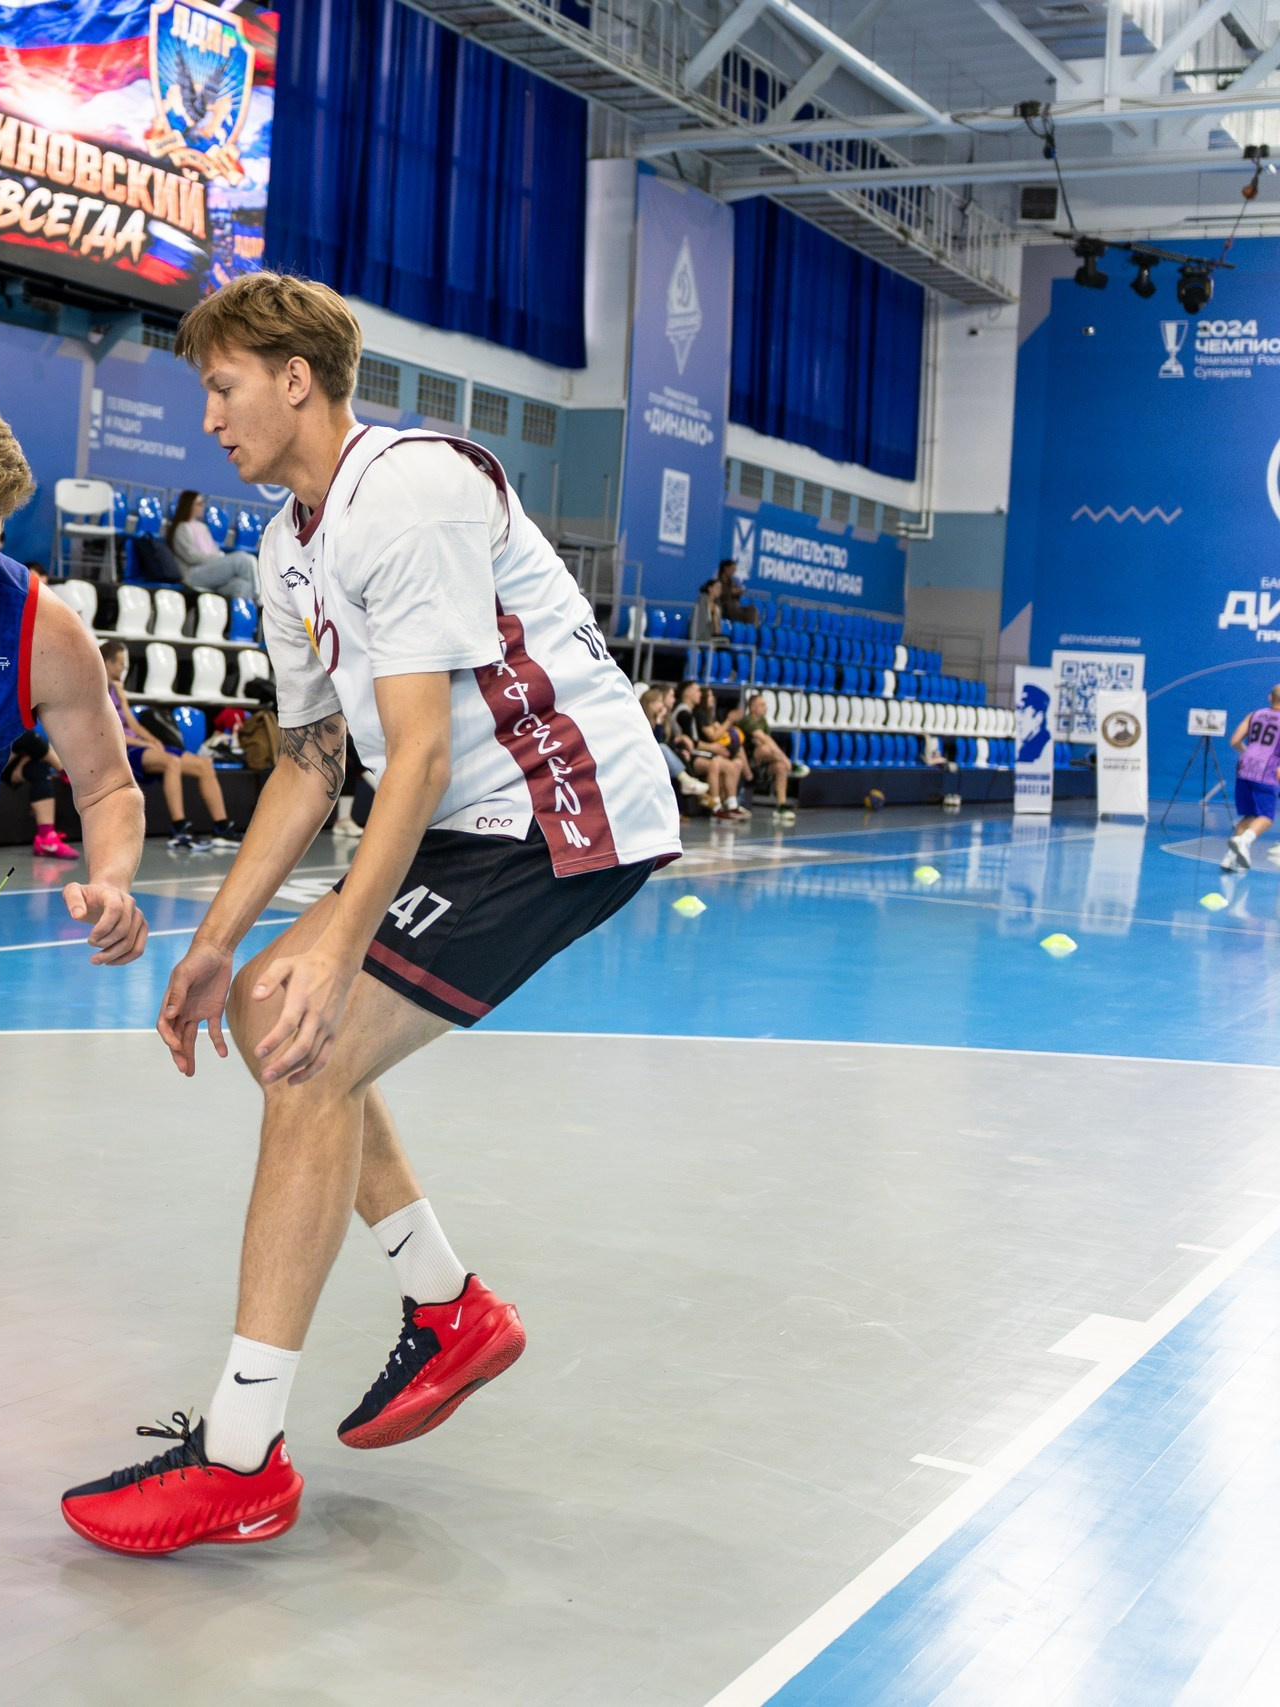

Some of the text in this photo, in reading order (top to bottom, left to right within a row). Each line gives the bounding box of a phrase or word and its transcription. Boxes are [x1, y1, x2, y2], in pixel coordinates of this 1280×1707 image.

[1197, 320, 1258, 338] 2024
[760, 528, 848, 569] ПРАВИТЕЛЬСТВО
[758, 555, 863, 596] ПРИМОРСКОГО КРАЯ
[388, 885, 452, 938] 47
